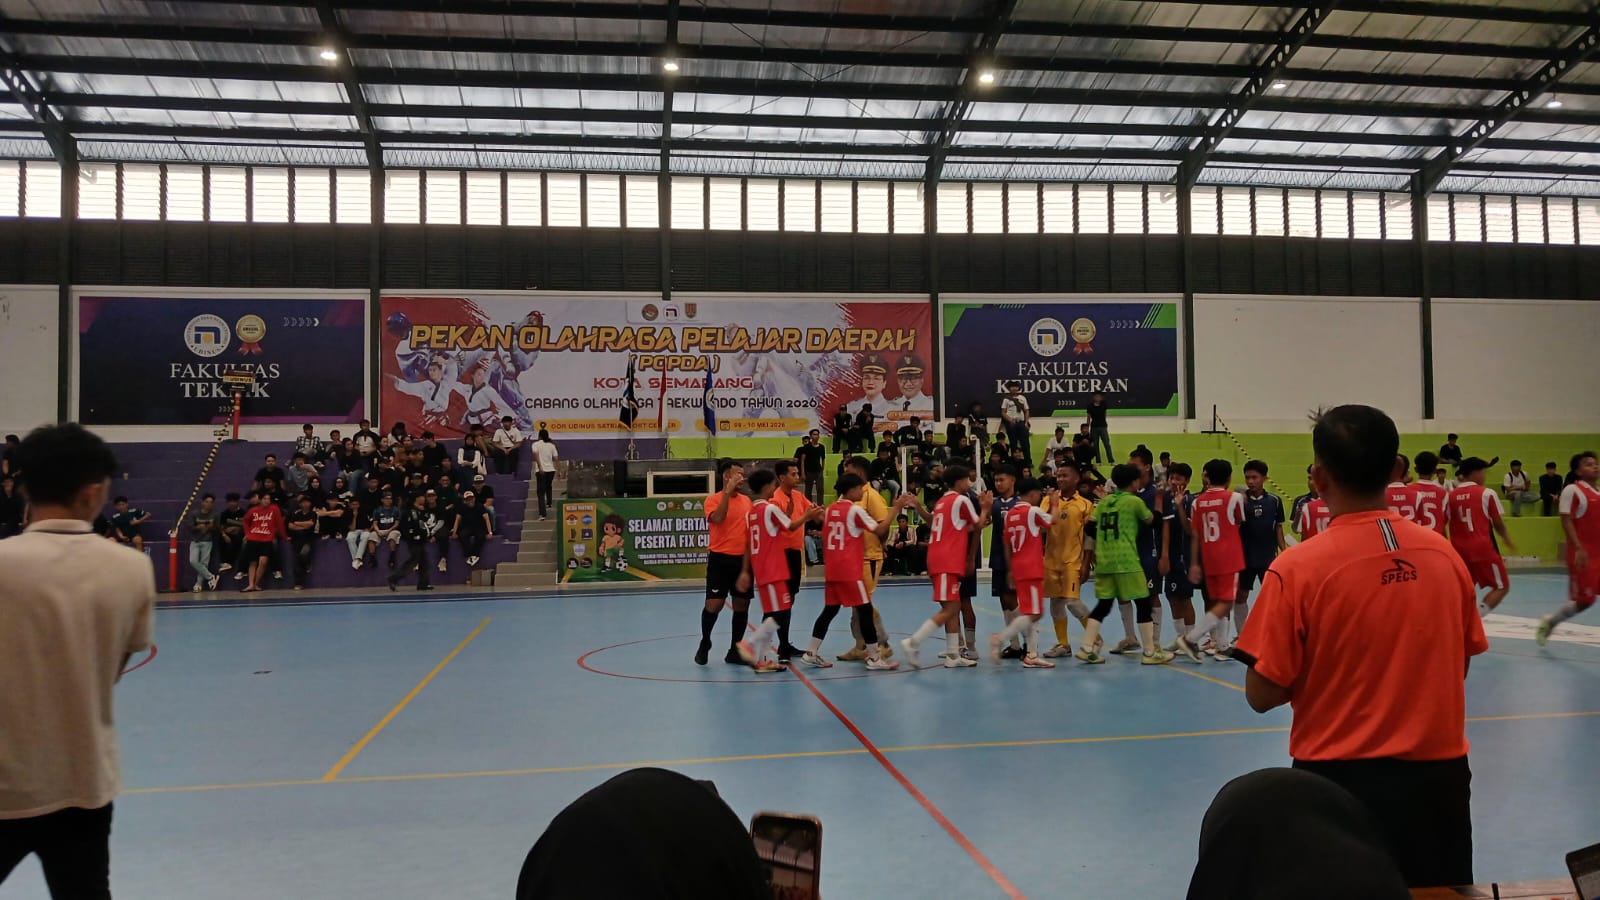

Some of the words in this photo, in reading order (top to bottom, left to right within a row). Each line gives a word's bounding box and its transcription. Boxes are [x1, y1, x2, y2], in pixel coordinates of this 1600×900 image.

[410, 324, 512, 351] PEKAN
[517, 325, 677, 352] OLAHRAGA
[681, 326, 802, 353] PELAJAR
[805, 327, 917, 352] DAERAH
[1018, 361, 1109, 377] FAKULTAS
[180, 382, 270, 398] TEKK
[524, 397, 580, 409] CABANG
[583, 397, 654, 409] OLAHGA
[658, 397, 737, 409] AEKWNDO
[741, 397, 783, 408] TAHUN
[786, 399, 818, 408] 2026
[628, 518, 673, 533] SELAMAT
[1458, 504, 1474, 532] 4
[1202, 511, 1220, 543] 18
[634, 535, 676, 549] PESERTA
[679, 535, 695, 548] FIX
[1381, 570, 1418, 585] SPECS
[1170, 582, 1177, 592] 9
